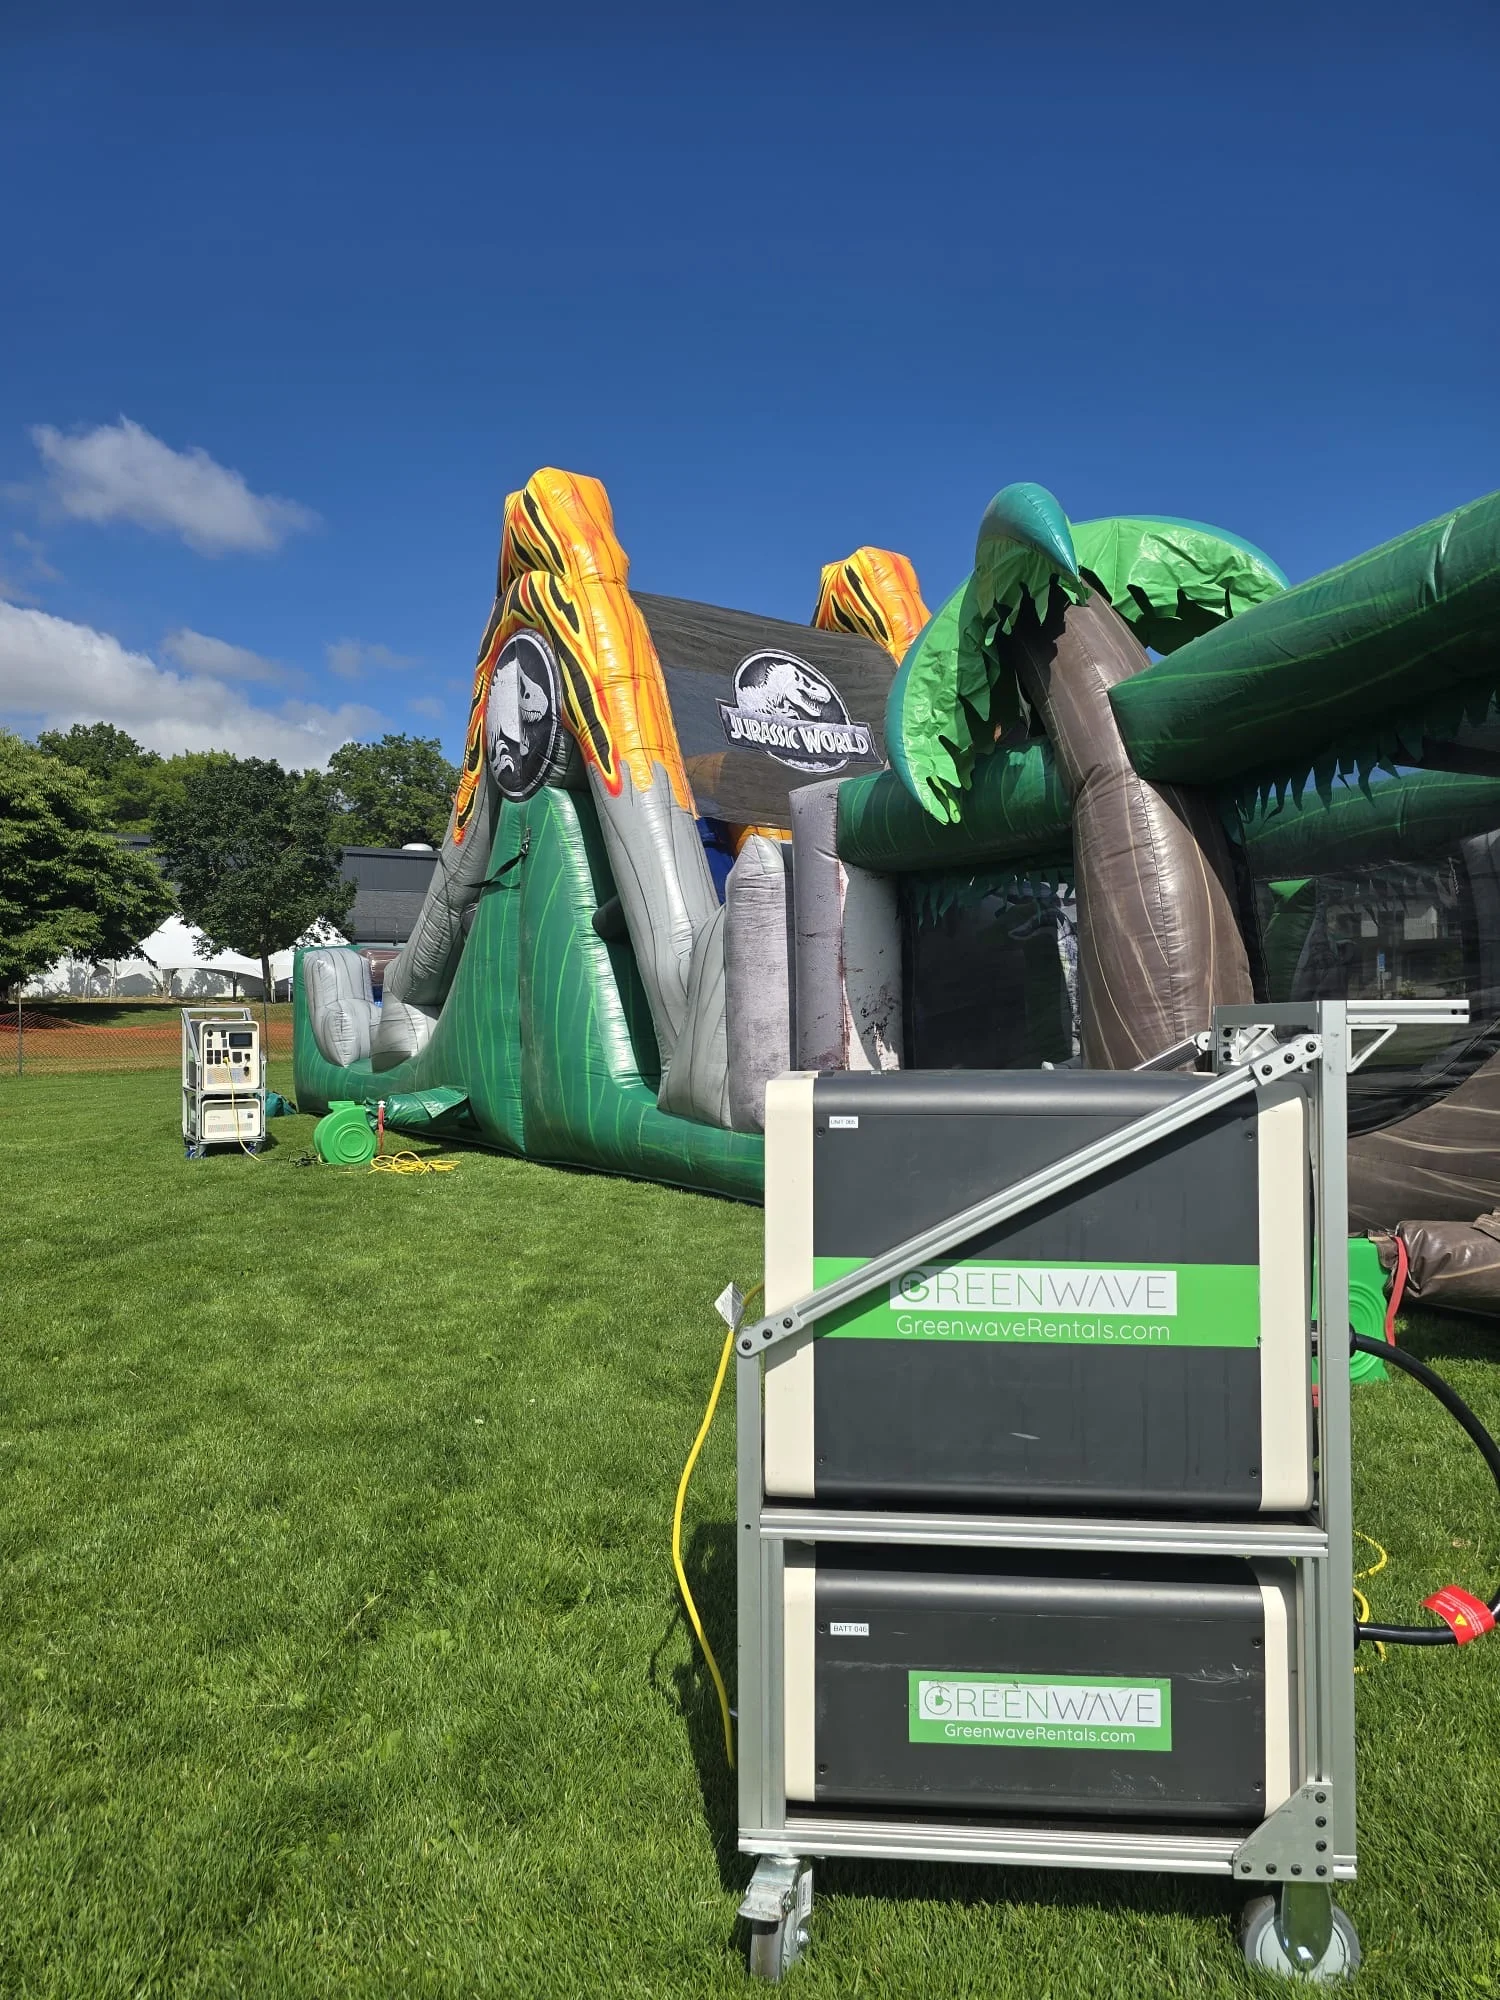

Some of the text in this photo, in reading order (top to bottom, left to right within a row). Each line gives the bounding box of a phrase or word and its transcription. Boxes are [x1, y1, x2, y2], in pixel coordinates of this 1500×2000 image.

[728, 712, 869, 754] JURASSIC WORLD
[899, 1269, 1168, 1309] GREENWAVE
[896, 1314, 1171, 1341] GreenwaveRentals.com
[924, 1685, 1155, 1723] GREENWAVE
[943, 1723, 1136, 1744] GreenwaveRentals.com
